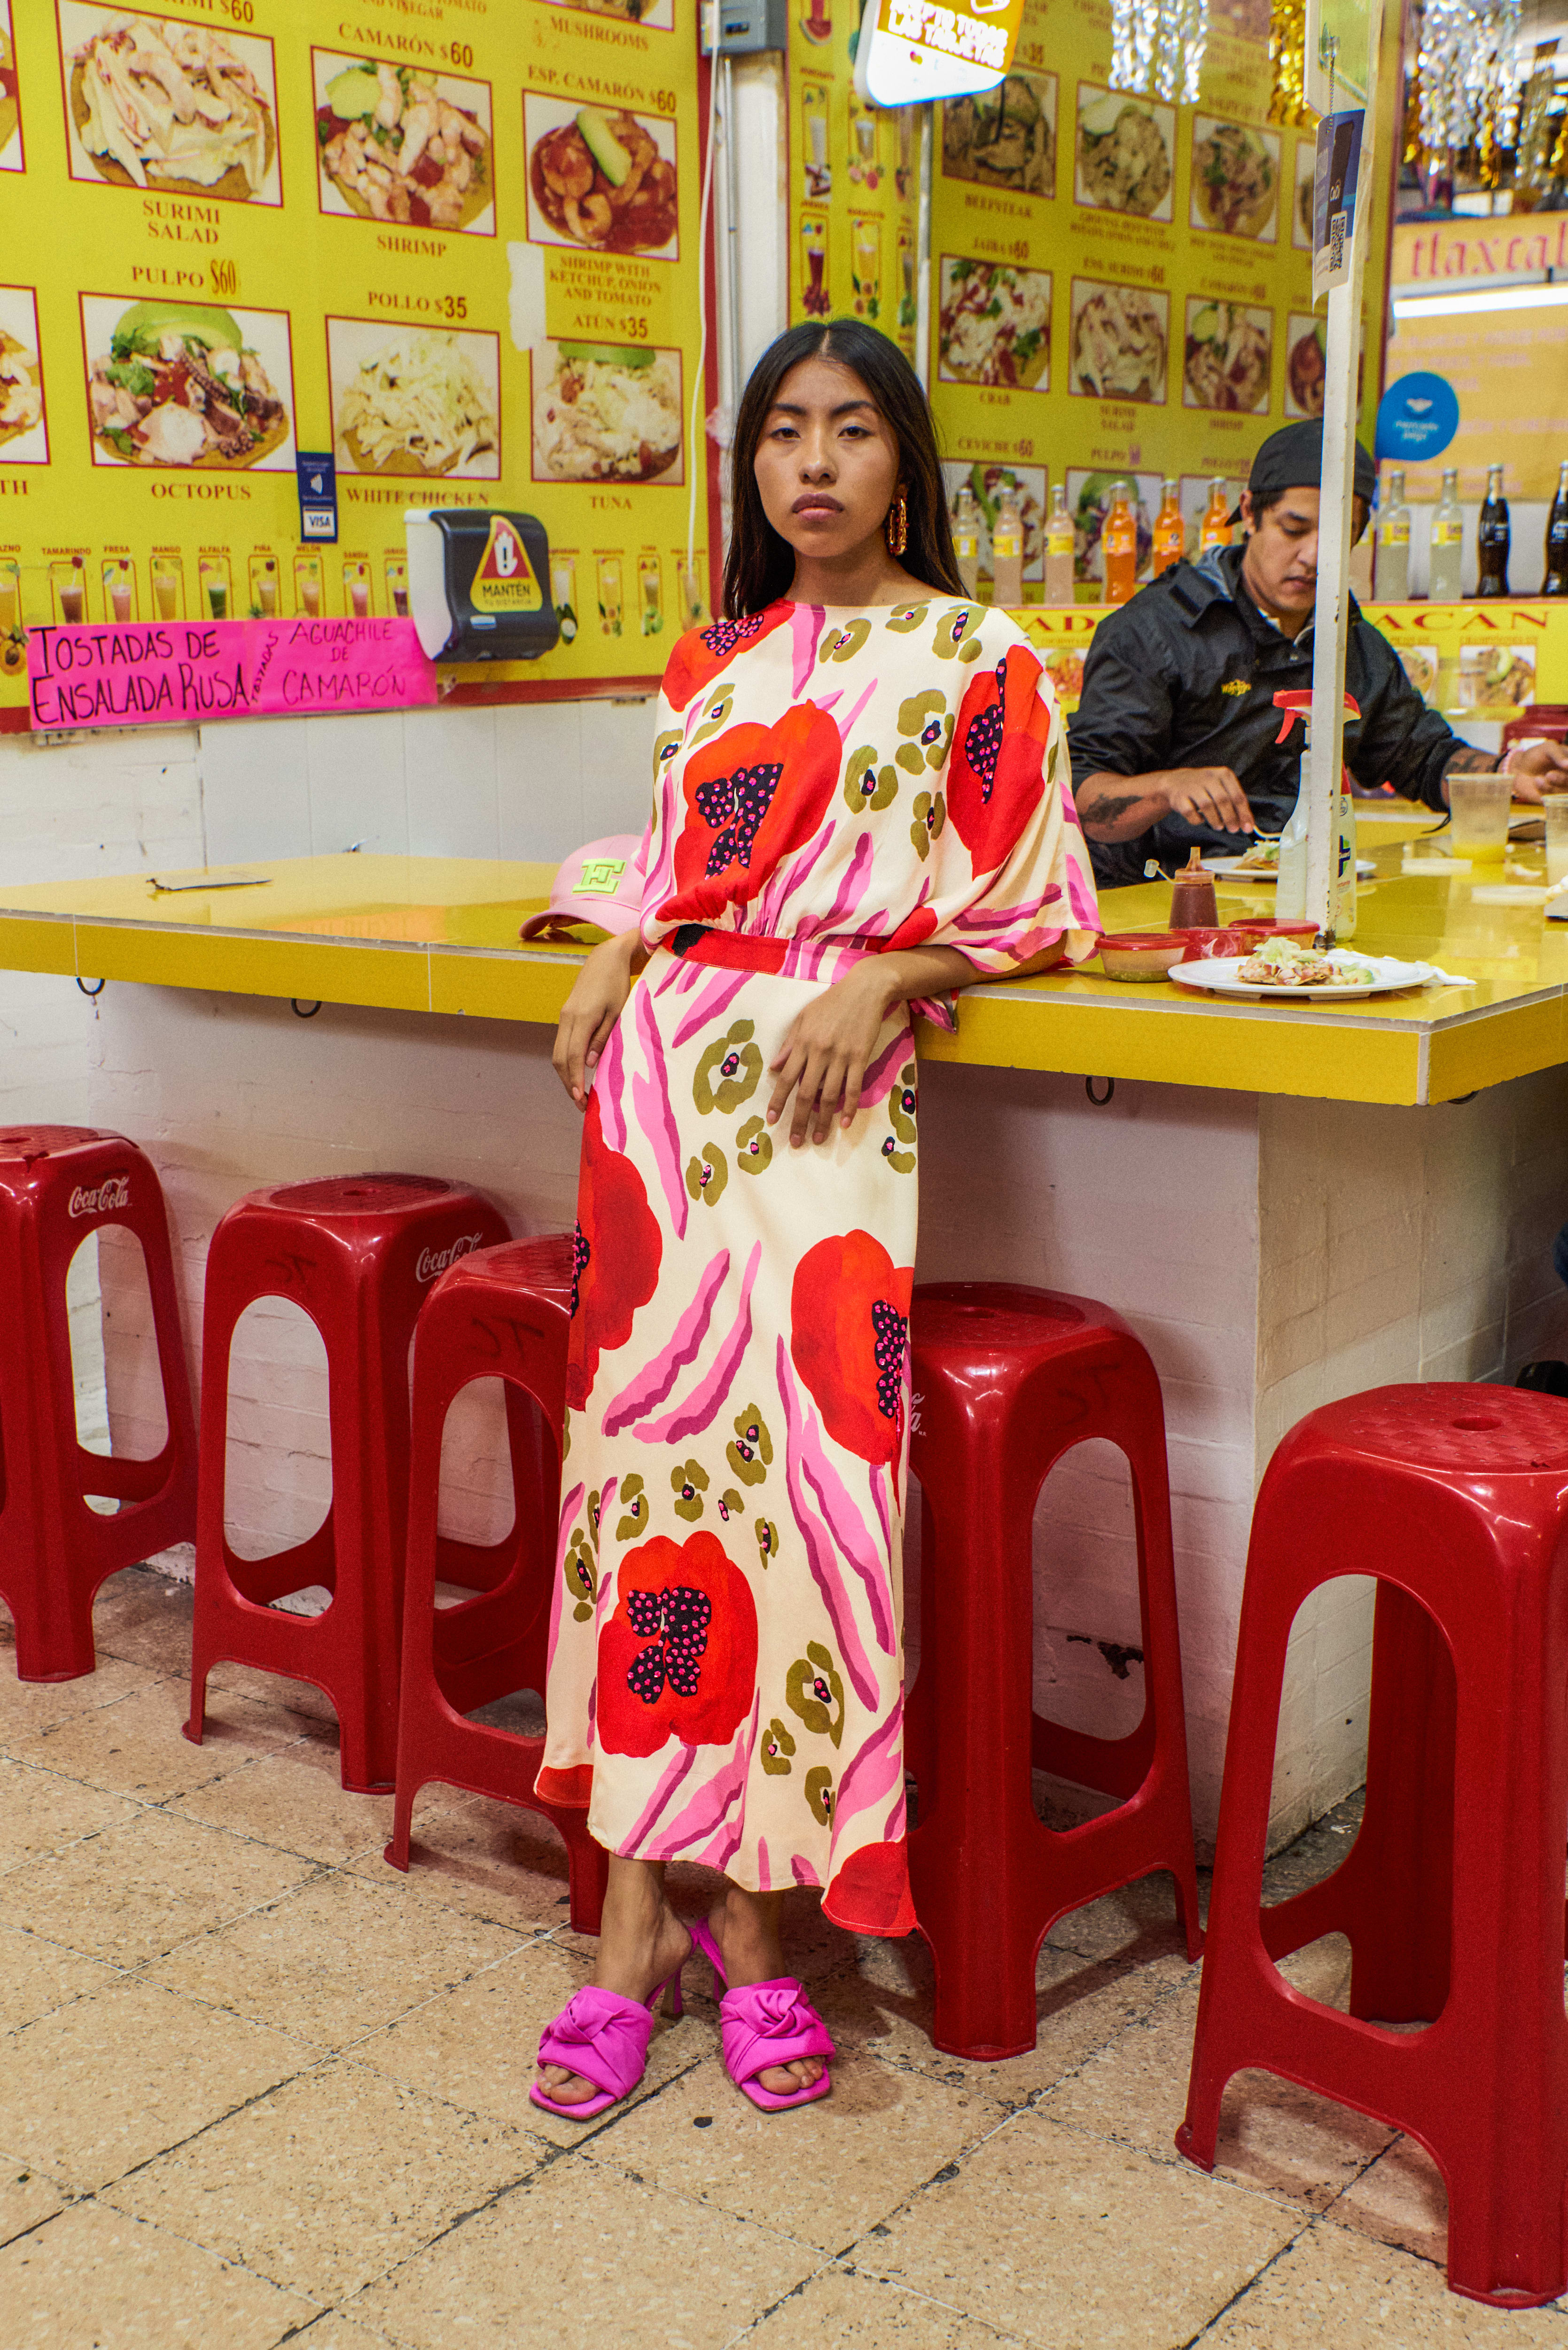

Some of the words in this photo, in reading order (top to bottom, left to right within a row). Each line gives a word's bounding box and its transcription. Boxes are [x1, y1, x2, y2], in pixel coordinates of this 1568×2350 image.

[549, 16, 649, 51] MUSHROOMS
[339, 23, 434, 57] CAMARÓN
[440, 41, 473, 68] $60
[528, 65, 559, 86] ESP.
[563, 72, 644, 102] CAMARÓN
[142, 200, 220, 226] SURIMI
[148, 220, 219, 245] SALAD
[376, 235, 446, 258] SHRIMP
[132, 266, 204, 289] PULPO
[210, 259, 236, 295] $60
[560, 256, 612, 274] SHRIMP
[615, 262, 650, 278] WITH
[618, 276, 662, 294] ONION
[368, 291, 429, 313] POLLO
[434, 296, 468, 319] $35
[564, 287, 593, 302] AND
[596, 291, 652, 308] TOMATO
[573, 313, 618, 331] ATÚN
[151, 483, 252, 501] OCTOPUS
[346, 488, 405, 507] WHITE
[408, 489, 490, 508] CHICKEN
[589, 495, 633, 511] TUNA
[309, 516, 332, 528] VISA
[42, 547, 91, 556] TAMARINDO
[103, 546, 130, 554] FRESA
[152, 546, 181, 554] MANGO
[198, 546, 231, 554] ALFALFA
[254, 544, 271, 553] PIÑA
[483, 582, 530, 597] MANTÉN
[289, 620, 393, 646] AGUACHILE
[30, 627, 173, 674] TOSTADAS
[186, 629, 220, 659] DE
[330, 646, 349, 662] DE
[32, 673, 174, 725] ENSALADA
[178, 662, 250, 712] RUSA
[282, 664, 406, 706] CAMARÓN
[68, 1176, 130, 1218] Coca-Cola
[415, 1232, 483, 1284] Coca-Cl
